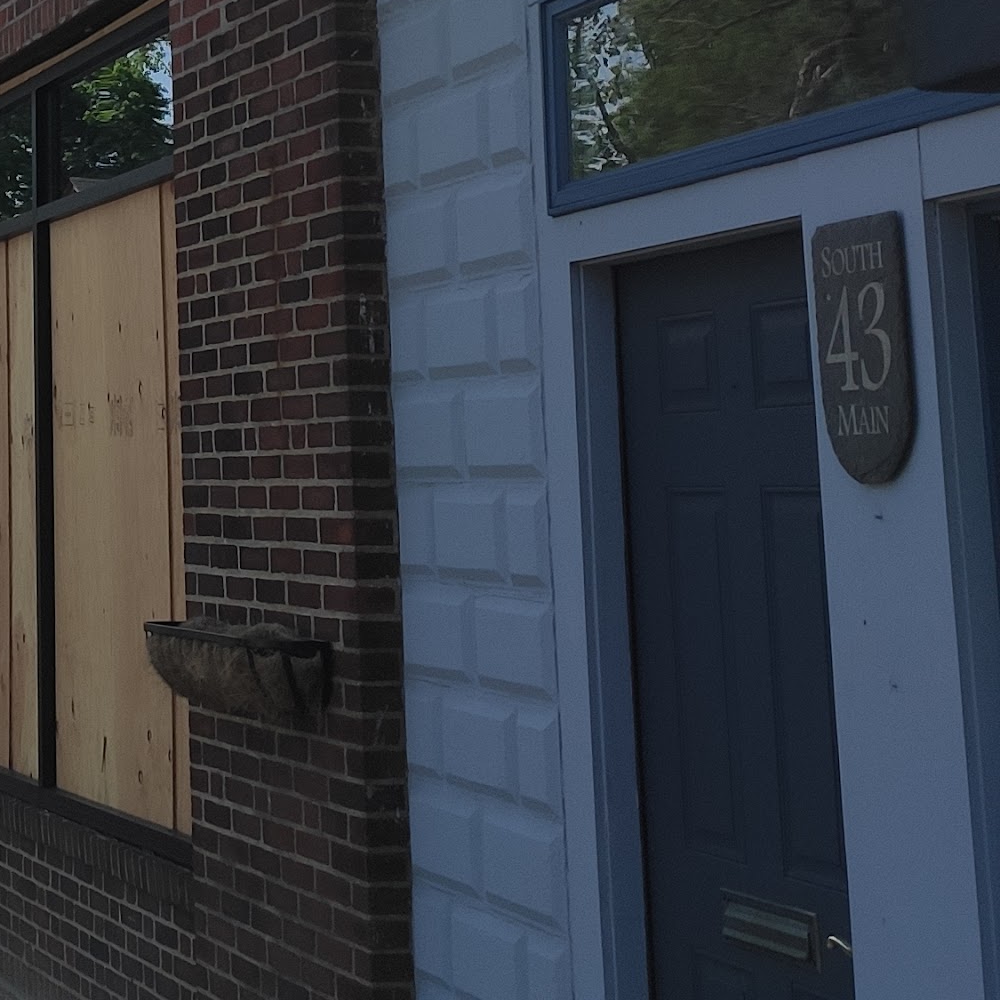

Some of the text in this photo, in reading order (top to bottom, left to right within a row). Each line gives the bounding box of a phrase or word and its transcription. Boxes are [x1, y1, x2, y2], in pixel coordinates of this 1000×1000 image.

[821, 241, 884, 278] SOUTH
[825, 281, 892, 392] 43
[837, 405, 890, 436] MAIN
